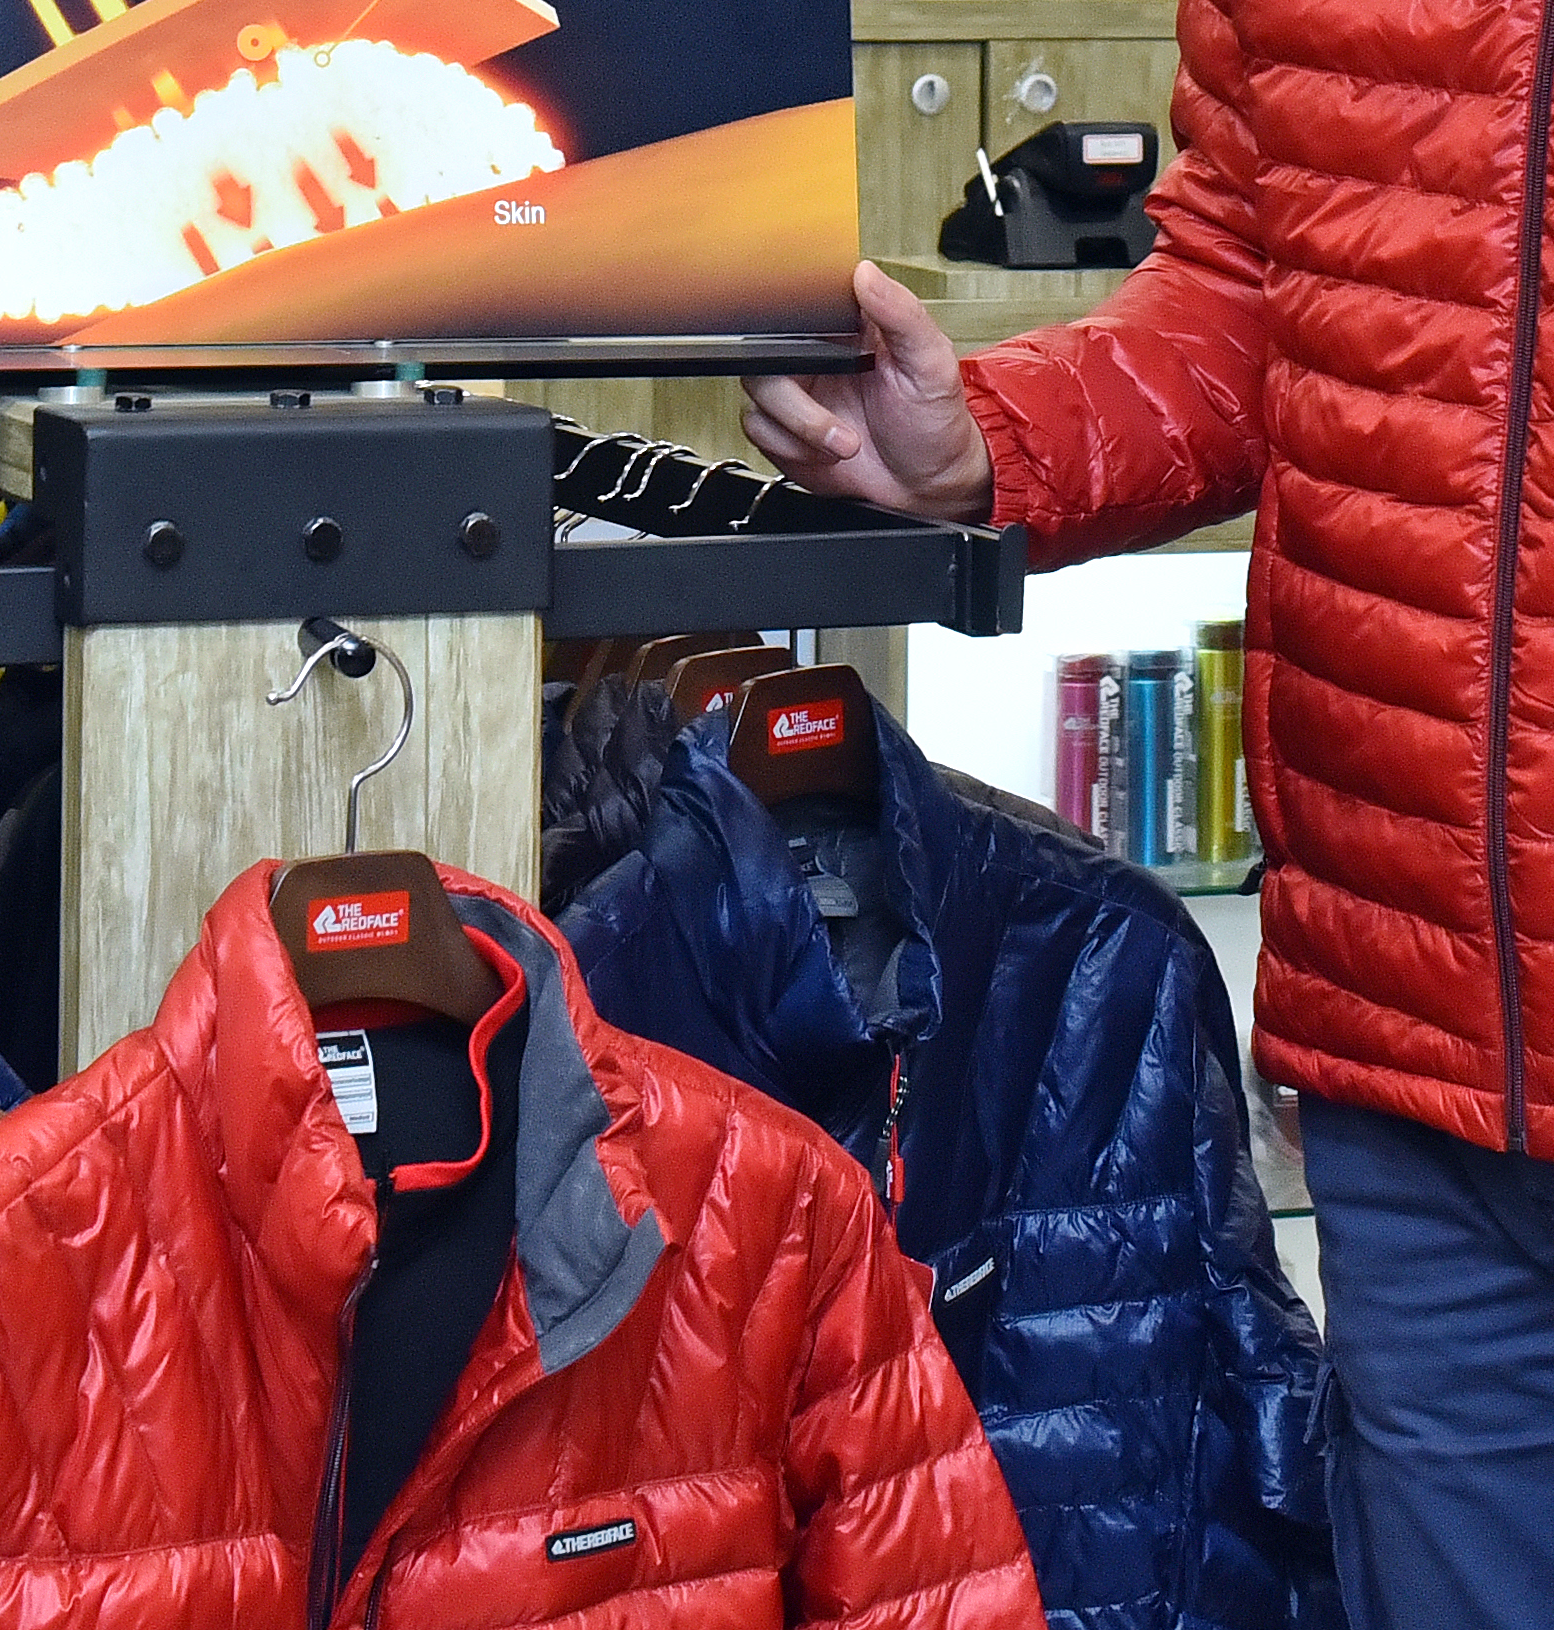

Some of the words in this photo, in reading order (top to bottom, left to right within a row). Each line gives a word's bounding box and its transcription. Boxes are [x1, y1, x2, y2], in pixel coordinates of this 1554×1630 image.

[493, 199, 546, 227] Skin
[790, 710, 809, 724] THE
[792, 717, 837, 736] REDFACE
[337, 902, 363, 917] THE
[341, 912, 400, 932] REDFACE
